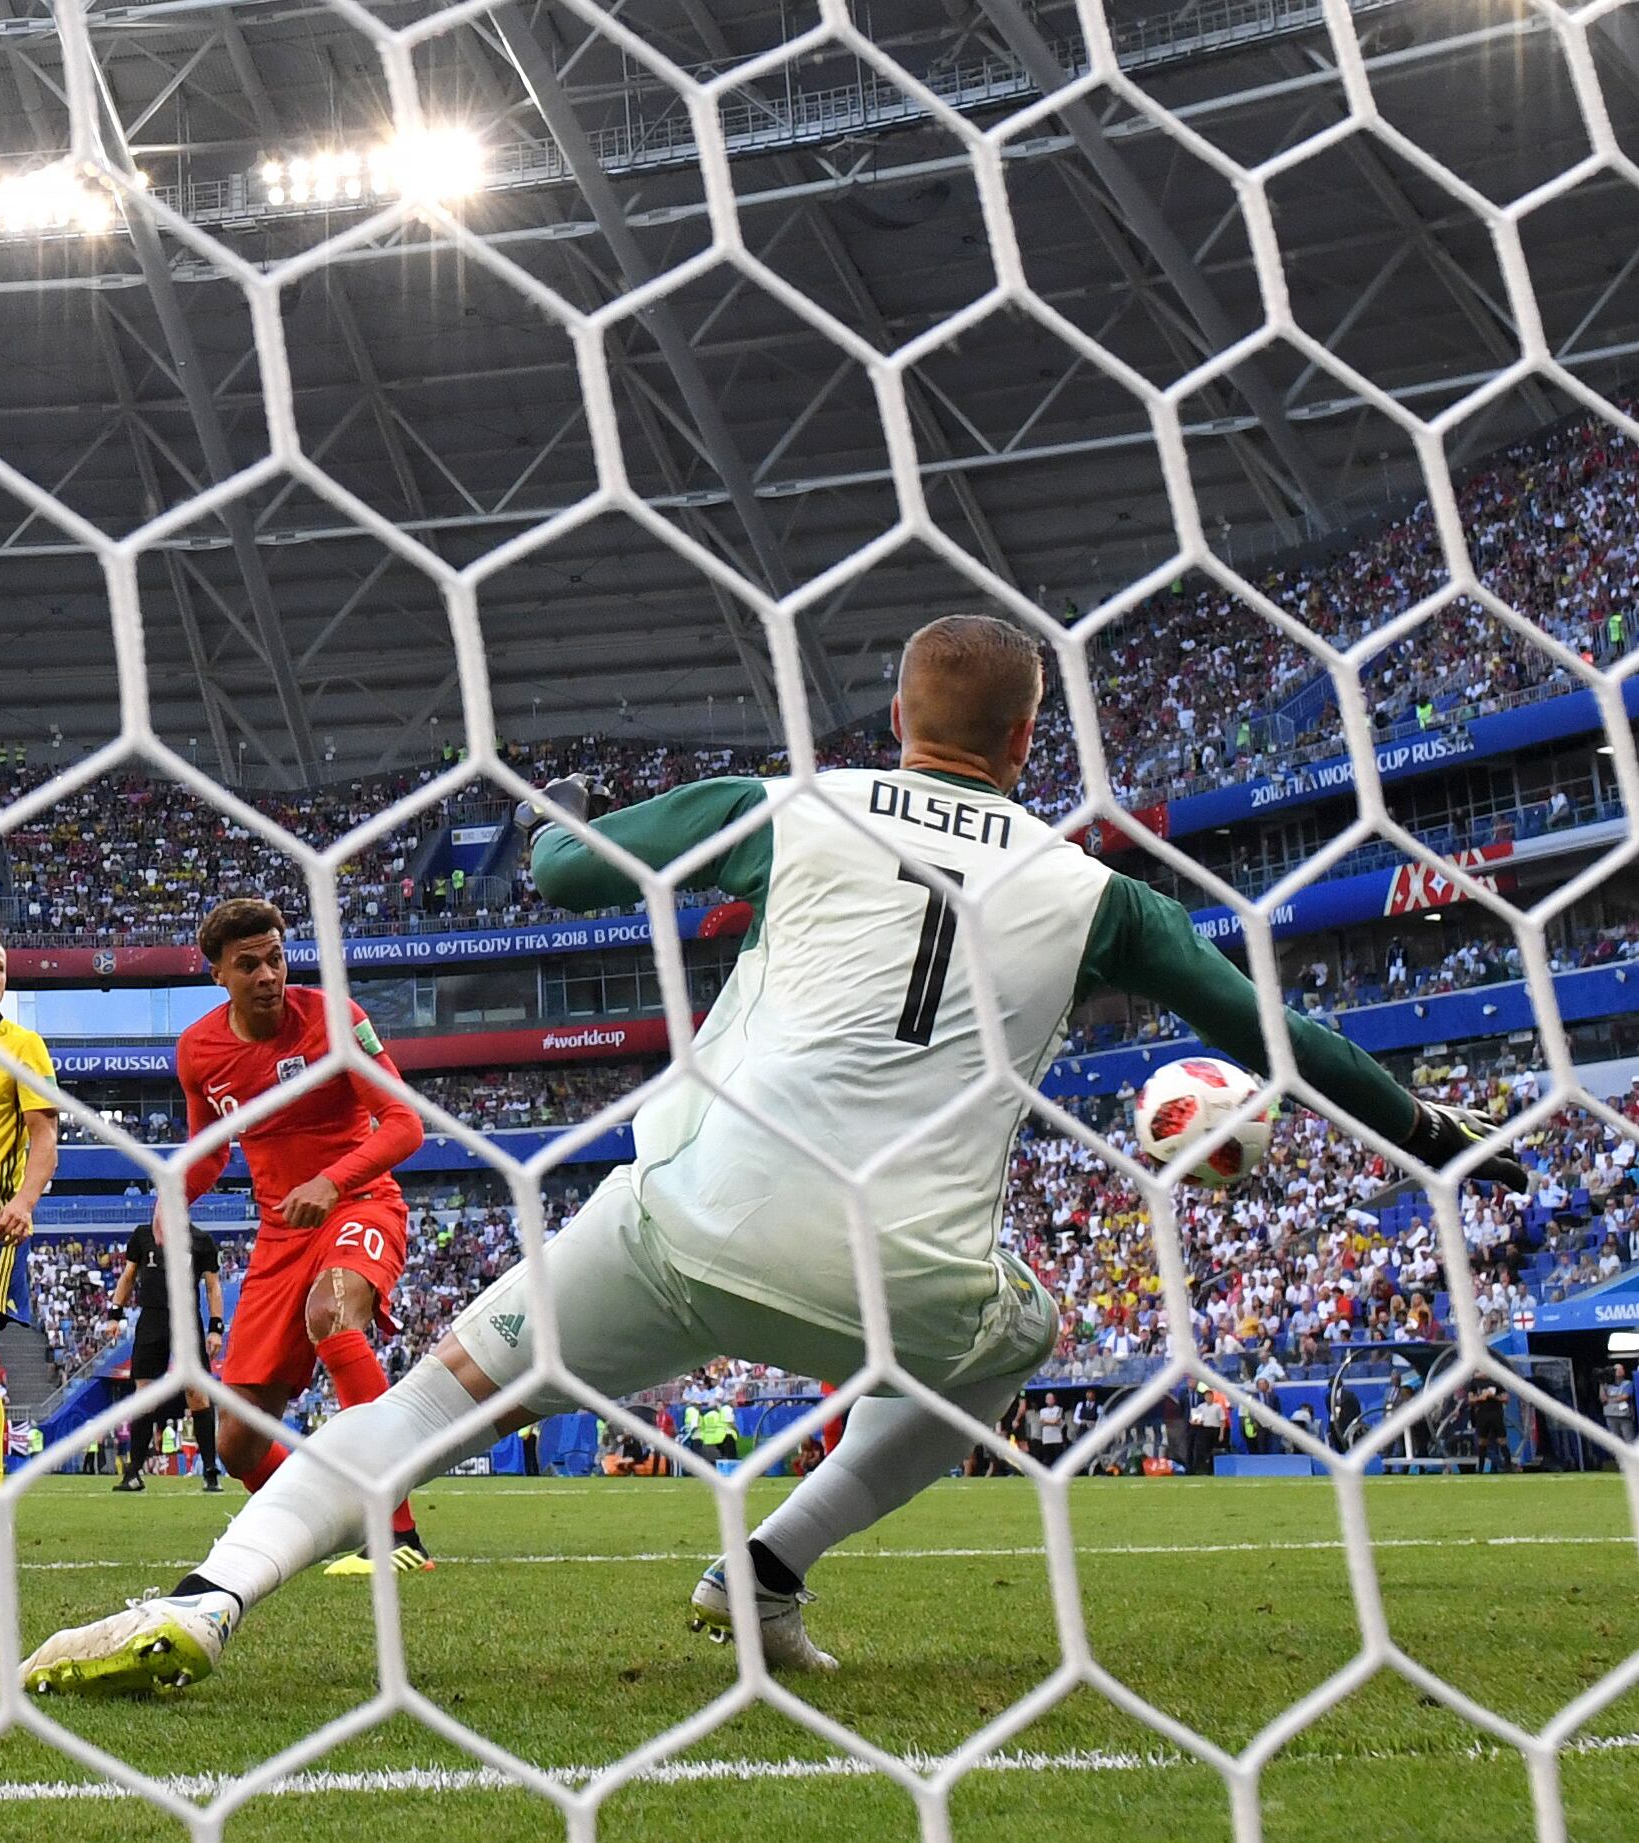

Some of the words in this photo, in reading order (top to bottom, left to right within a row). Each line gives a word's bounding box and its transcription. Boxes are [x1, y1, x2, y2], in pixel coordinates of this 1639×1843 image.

[1318, 760, 1355, 788] WOR
[1377, 747, 1410, 772] CUP
[869, 779, 1012, 849] OLSEN
[353, 943, 403, 960] МИРА
[406, 941, 431, 958] ПО
[435, 936, 511, 955] ФУТБОЛУ
[515, 933, 549, 950] FIFA
[552, 930, 588, 948] 2018
[594, 928, 606, 944] В
[609, 924, 652, 943] РОСС
[895, 858, 965, 1047] 1
[543, 1028, 625, 1050] #worldcup
[64, 1056, 101, 1072] CUP
[105, 1055, 169, 1071] RUSSIA
[335, 1221, 384, 1261] 20
